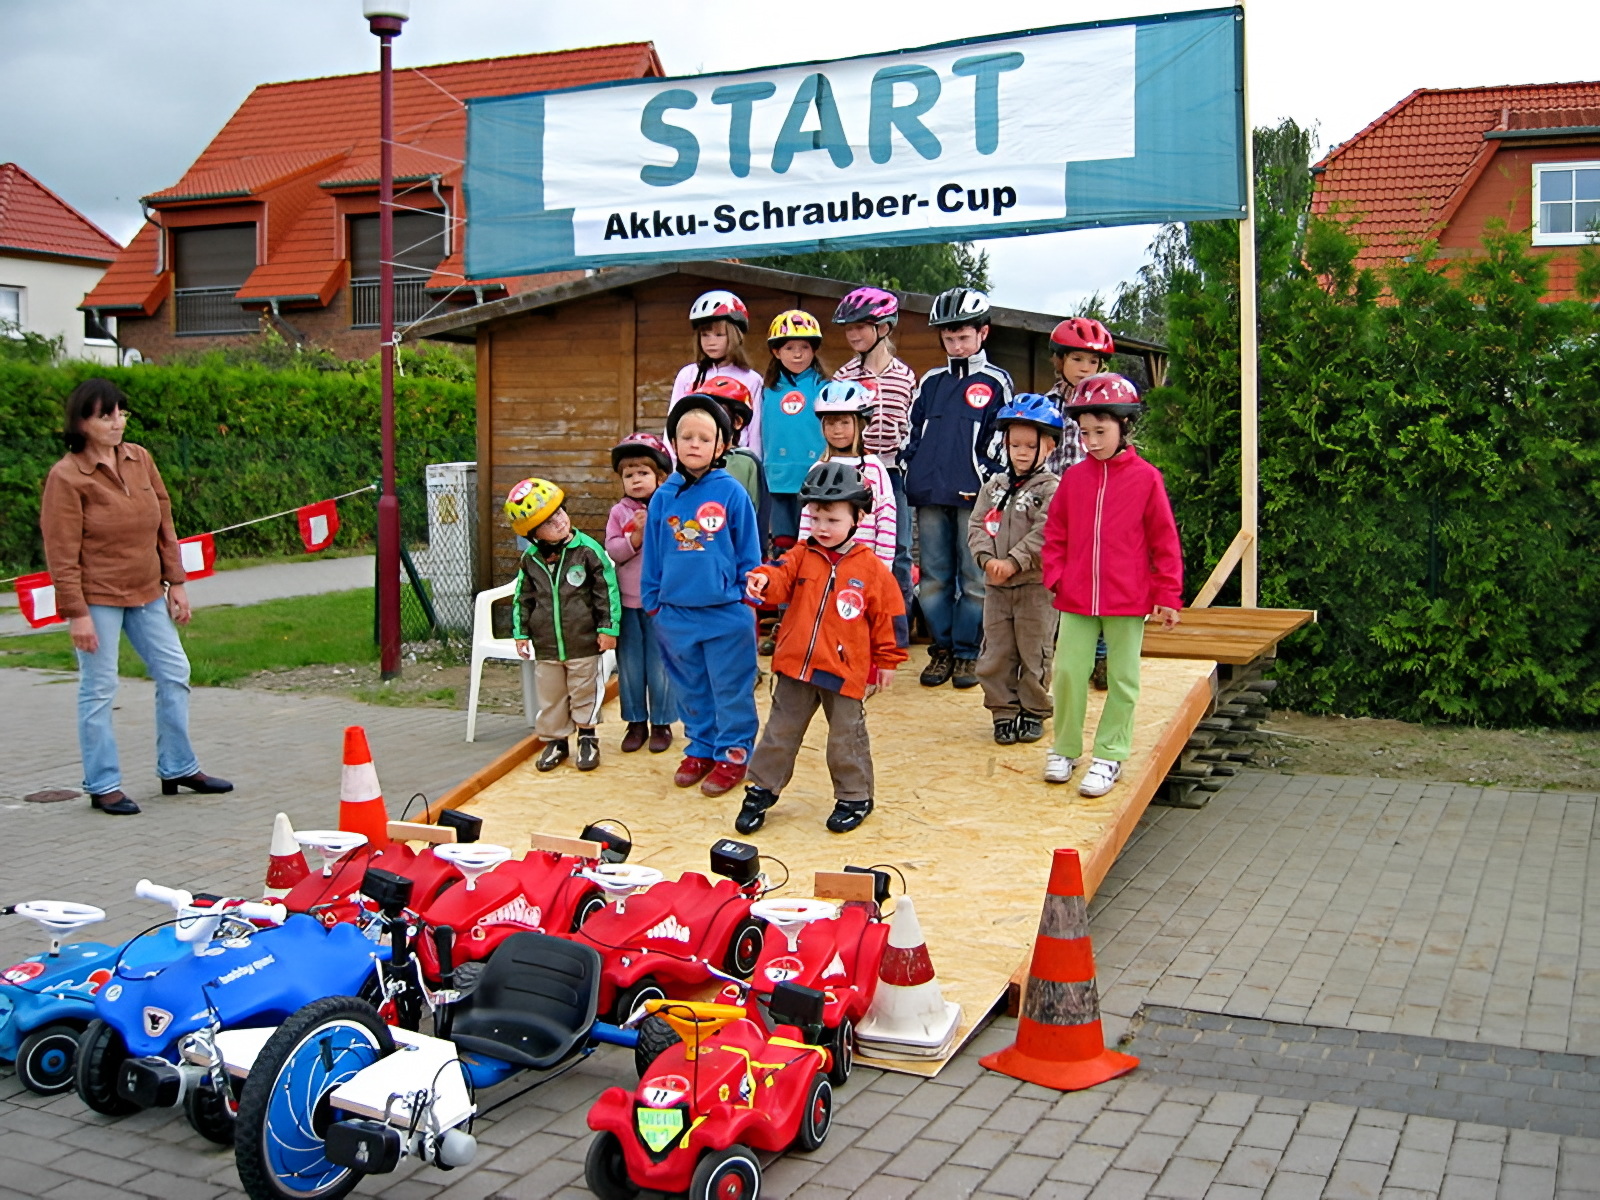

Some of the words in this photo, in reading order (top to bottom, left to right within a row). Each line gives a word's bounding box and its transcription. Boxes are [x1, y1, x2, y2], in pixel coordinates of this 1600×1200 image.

[640, 52, 1025, 187] START
[604, 183, 1017, 241] Akku-Schrauber-Cup
[653, 1089, 668, 1103] 11
